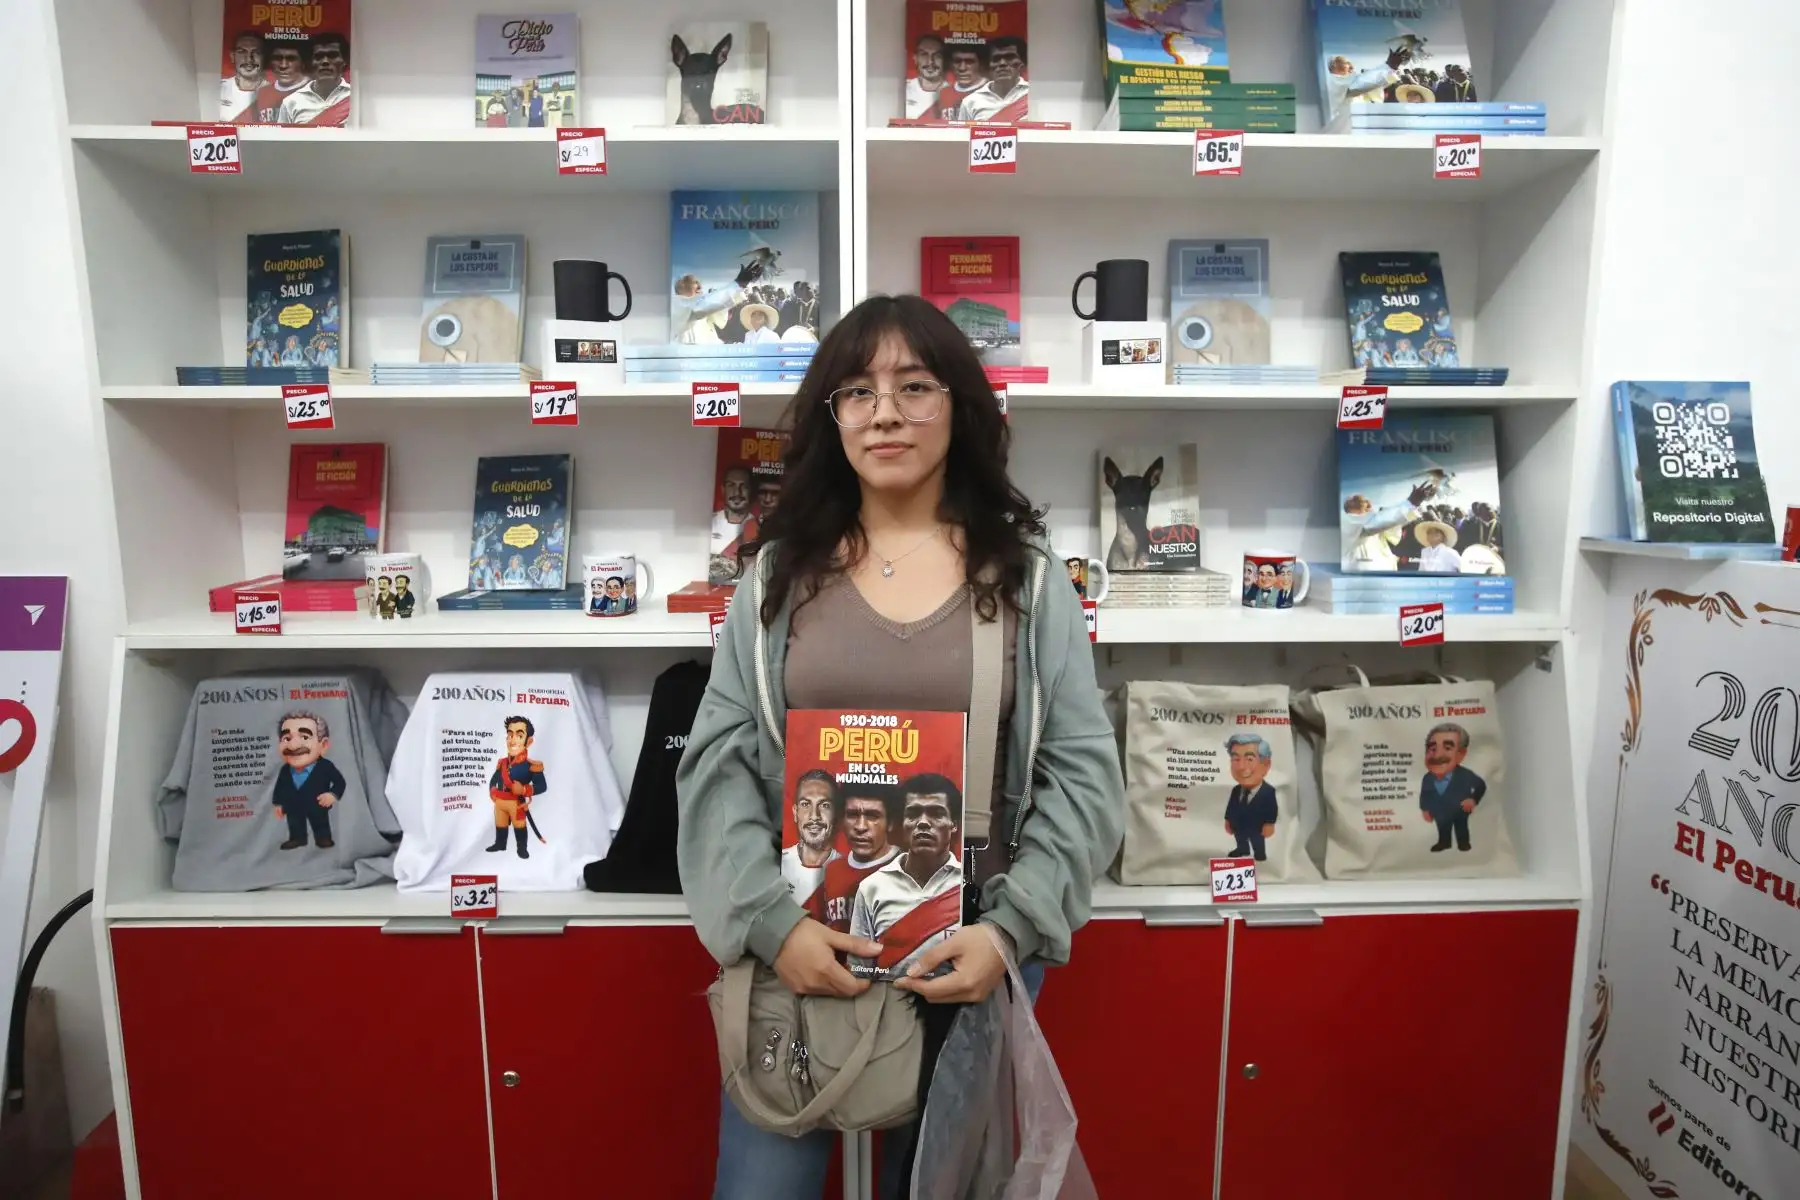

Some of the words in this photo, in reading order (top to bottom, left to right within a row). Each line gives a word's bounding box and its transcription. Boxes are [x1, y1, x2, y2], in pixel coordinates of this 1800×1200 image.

[932, 8, 998, 32] PERÚ
[712, 104, 760, 123] CAN
[562, 151, 571, 162] S/
[714, 220, 729, 230] EN
[732, 220, 746, 230] EL
[749, 219, 779, 230] PERÚ
[950, 254, 992, 263] PERUANOS
[950, 265, 960, 274] DE
[961, 264, 992, 274] FICCIÓN
[280, 282, 314, 298] SALUD
[1381, 294, 1420, 307] SALUD
[1675, 497, 1699, 505] Visita
[506, 504, 540, 518] SALUD
[1653, 512, 1721, 524] Repositorio
[1724, 512, 1764, 524] Digital
[1150, 523, 1196, 543] CAN
[1149, 542, 1196, 554] NUESTRO
[200, 690, 230, 705] 200
[233, 686, 278, 703] AÑOS
[290, 690, 300, 700] El
[432, 687, 461, 700] 200
[462, 685, 505, 702] AÑOS
[517, 693, 526, 703] El
[1150, 707, 1178, 722] 200
[1179, 709, 1224, 725] AÑOS
[1374, 703, 1421, 720] AÑOS
[1433, 706, 1445, 717] El
[839, 714, 898, 727] 1930-2018
[1236, 714, 1247, 725] El
[819, 719, 919, 763] PERÚ
[848, 763, 863, 774] EN
[864, 763, 886, 774] LOS
[835, 773, 899, 785] MUNDIALES
[1674, 821, 1705, 863] El
[1713, 838, 1800, 910] Peru
[1670, 927, 1705, 967] LA
[851, 965, 873, 974] Editora
[874, 966, 889, 974] Perú
[1674, 966, 1800, 1067] NARRAN
[1680, 1042, 1800, 1154] HISTORI
[1647, 1079, 1682, 1111] Somos
[1684, 1105, 1715, 1137] parte
[1716, 1133, 1731, 1151] de
